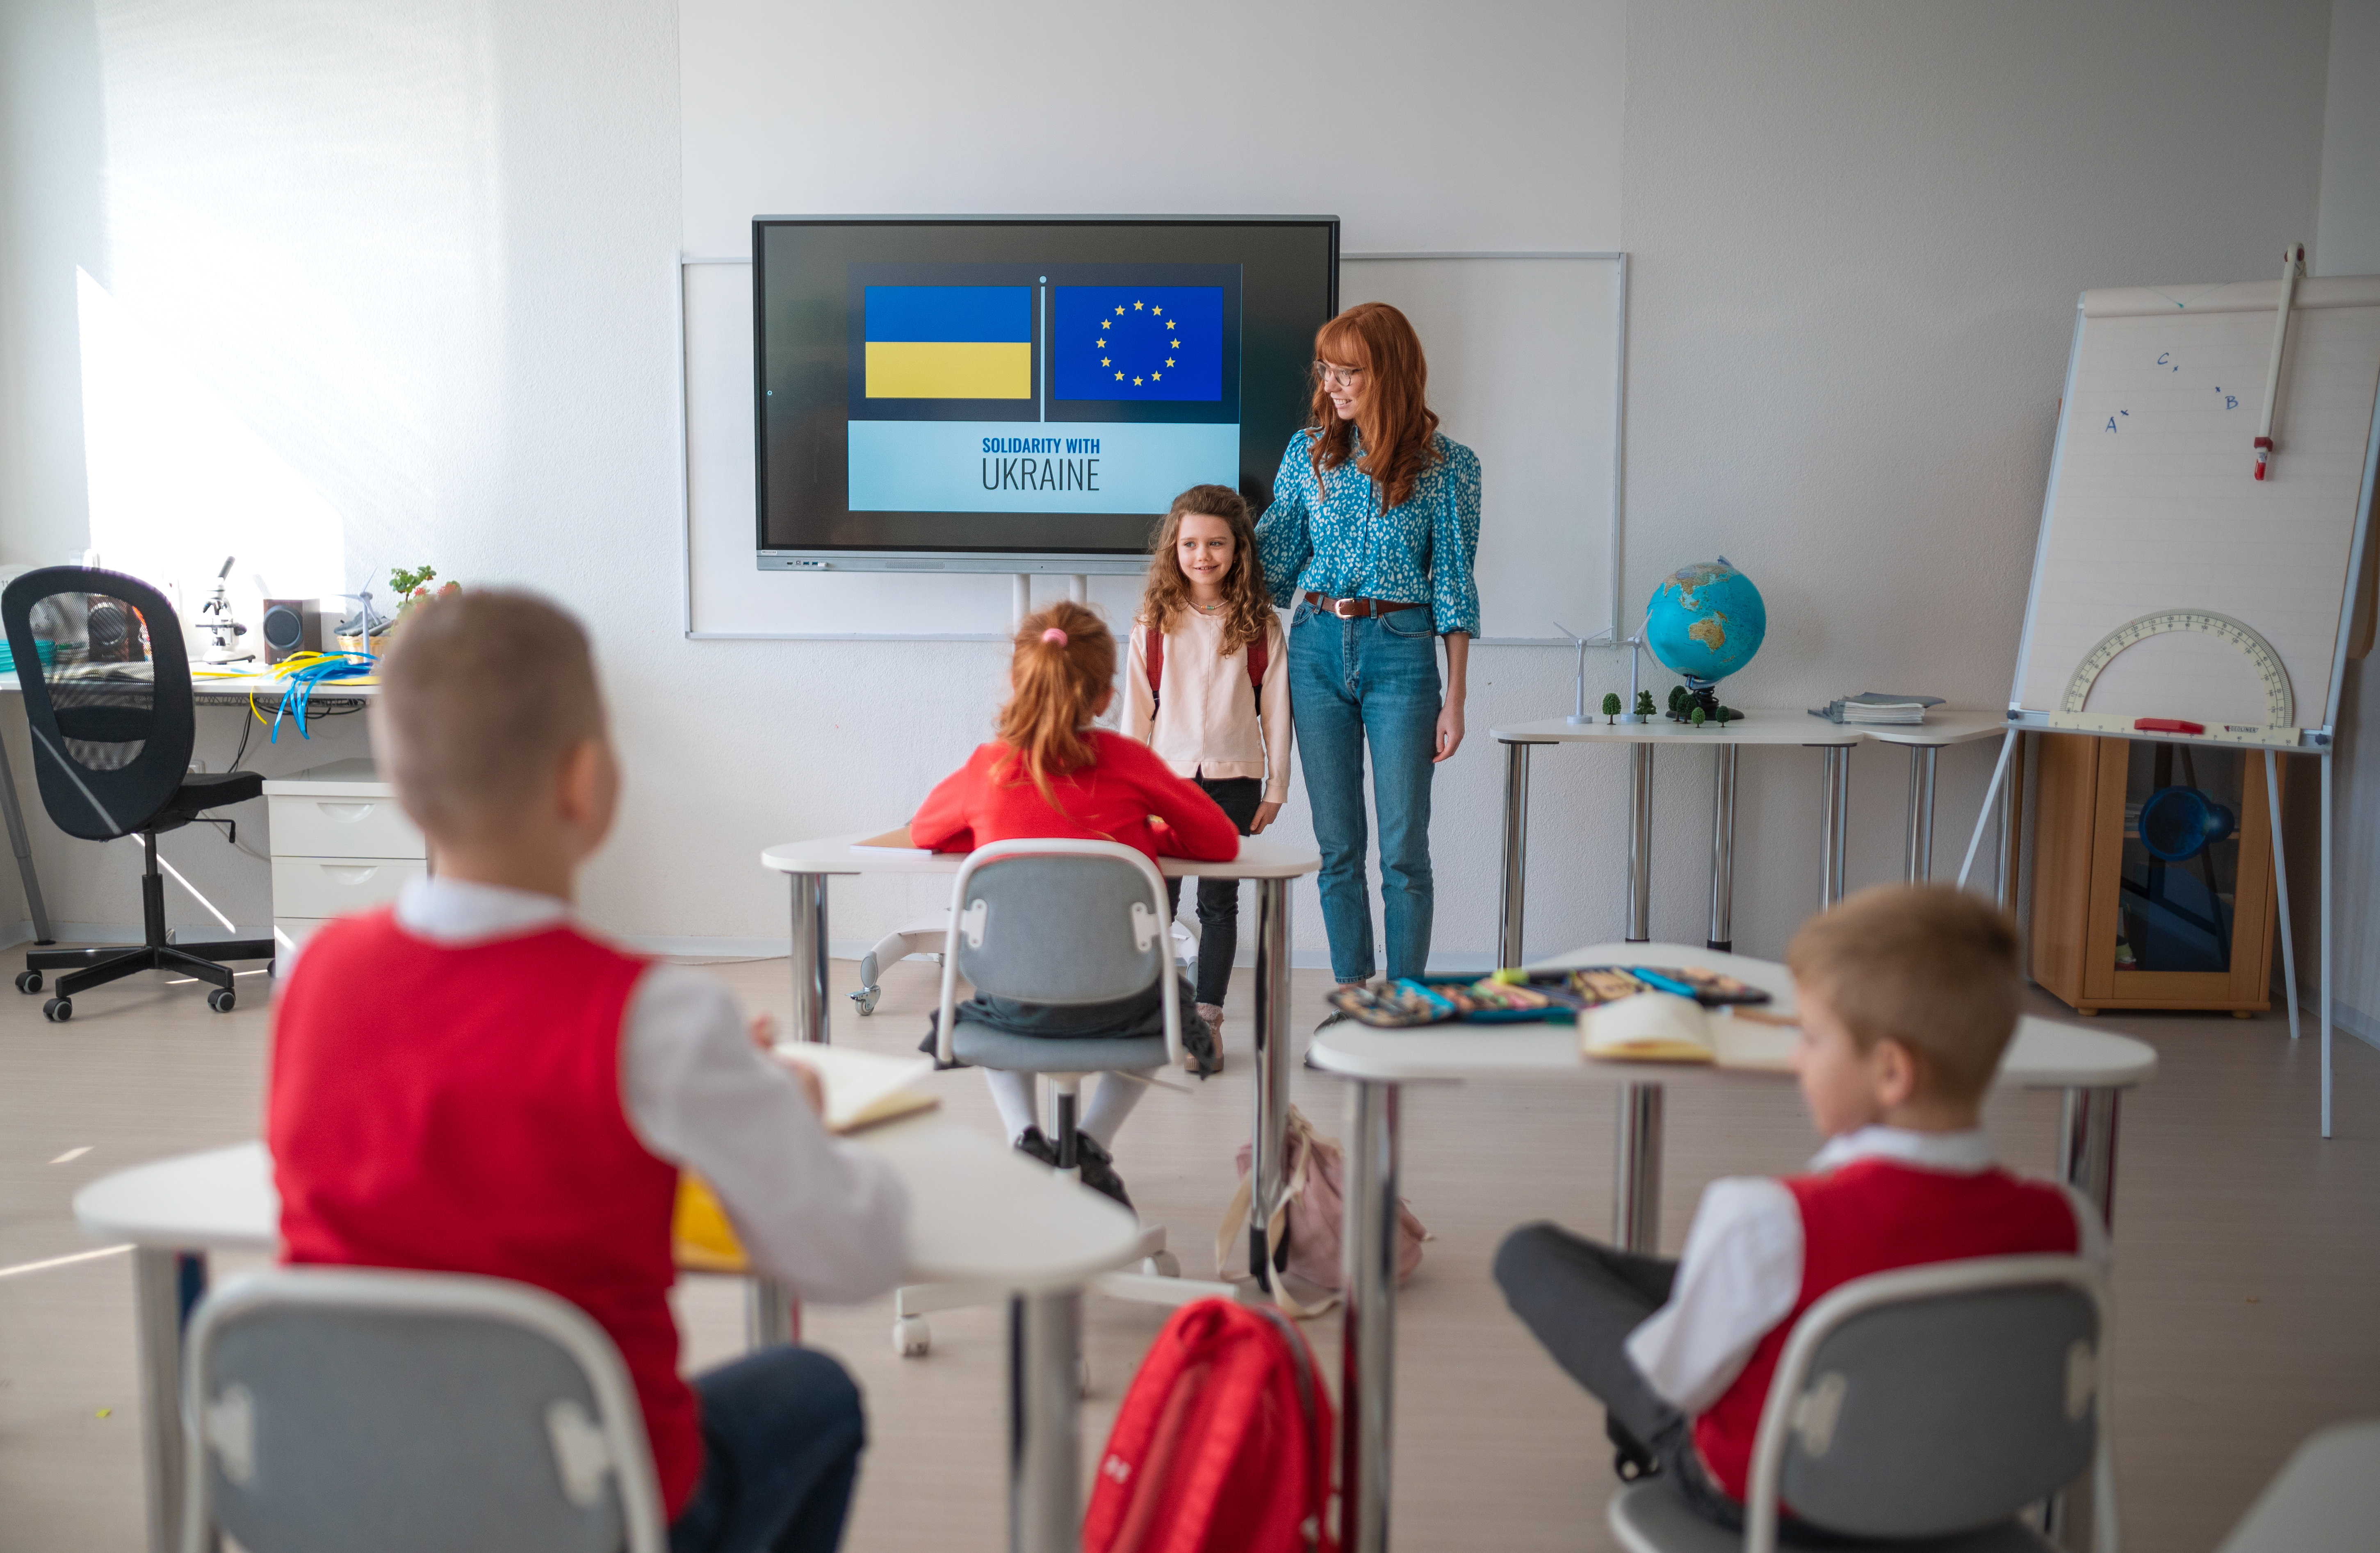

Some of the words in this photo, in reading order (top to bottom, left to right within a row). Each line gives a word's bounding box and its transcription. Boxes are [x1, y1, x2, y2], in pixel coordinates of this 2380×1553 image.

[2157, 353, 2169, 365] C
[2225, 396, 2239, 410] B
[2105, 416, 2117, 433] A
[983, 437, 1061, 453] SOLIDARITY
[1066, 438, 1100, 453] WITH
[983, 458, 1100, 491] UKRAINE
